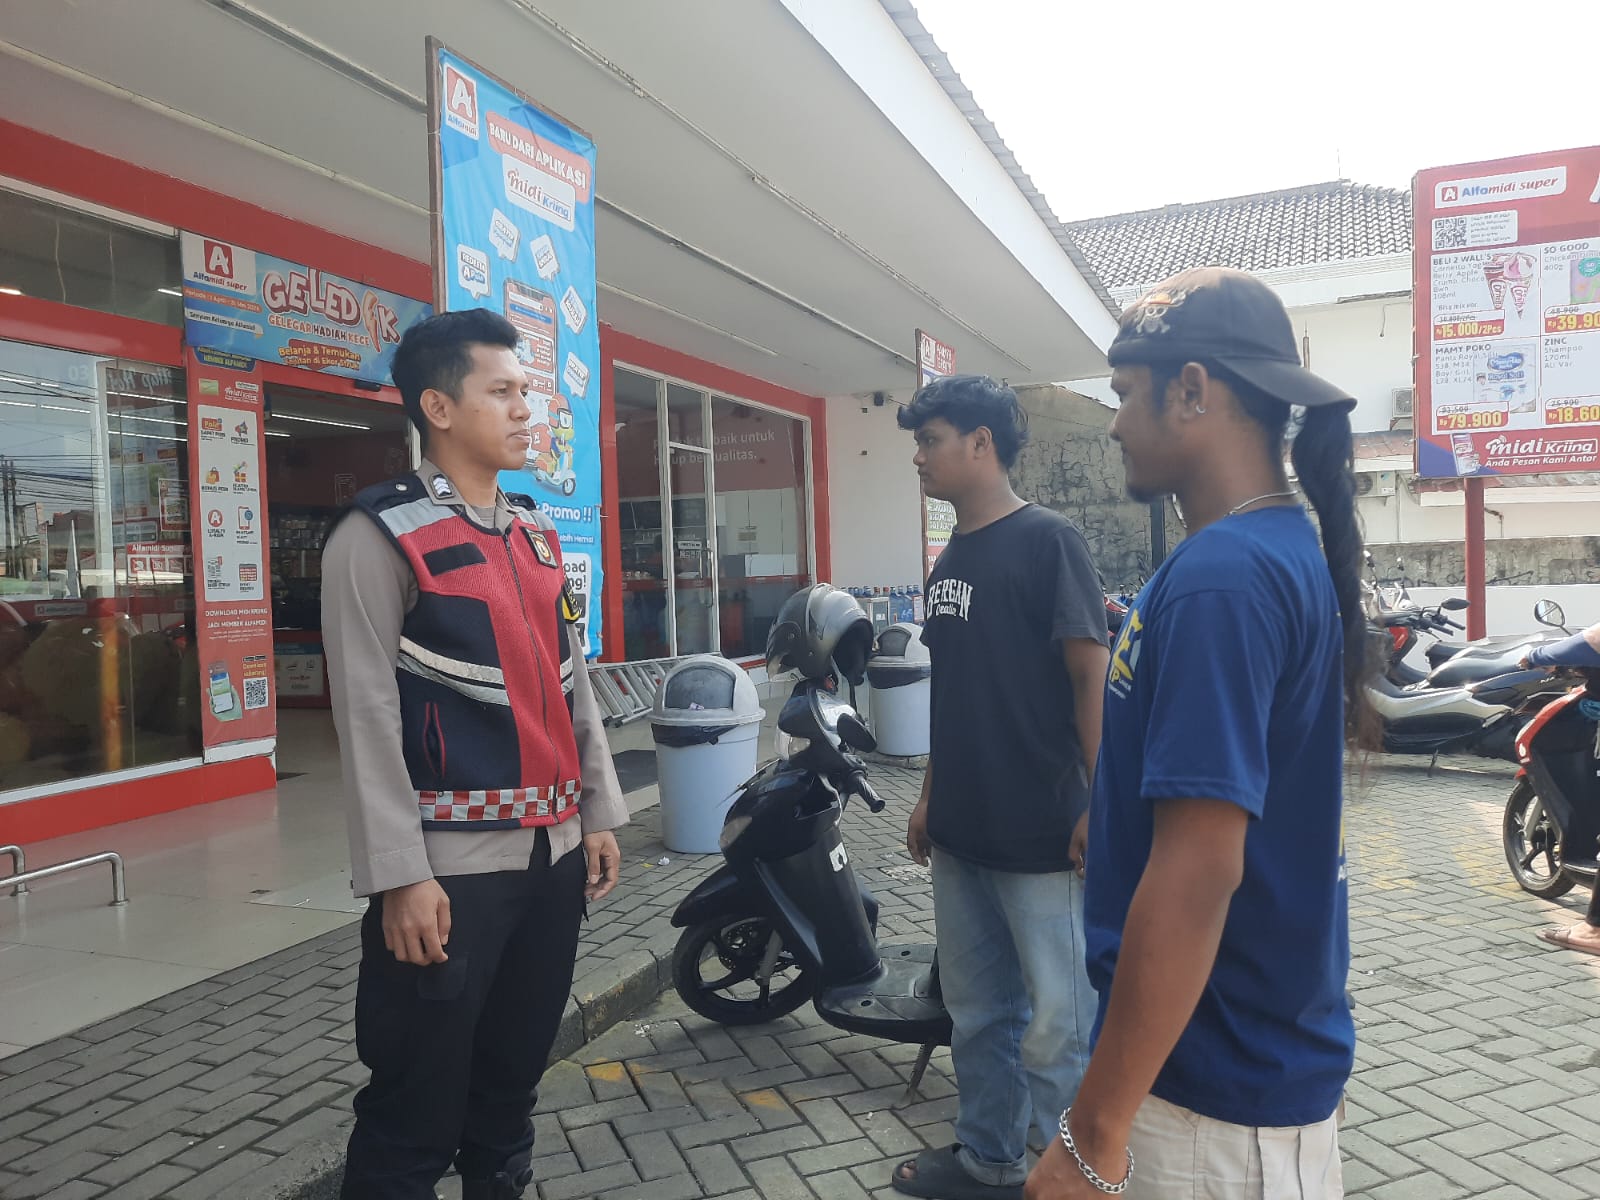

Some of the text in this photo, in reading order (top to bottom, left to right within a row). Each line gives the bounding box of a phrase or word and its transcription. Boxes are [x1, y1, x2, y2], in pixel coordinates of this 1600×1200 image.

[447, 114, 477, 137] Alfamidi
[489, 122, 586, 189] BARU DARI APLIKASI
[1461, 182, 1516, 198] Alfamidi
[1519, 176, 1558, 193] super
[507, 168, 569, 220] midi Kriing
[1543, 242, 1590, 255] SO GOOD
[1433, 257, 1451, 266] BELI
[1461, 254, 1491, 263] WALL'S
[1544, 252, 1577, 263] Chicken
[193, 270, 248, 292] Alfamidi super
[268, 314, 369, 346] GELEGAR HADIAH KECE
[1544, 337, 1567, 346] ZINC
[278, 345, 361, 361] Belanja & Temukan
[1435, 344, 1491, 355] MAMY POKO
[1544, 345, 1583, 354] Shampoo
[321, 356, 338, 366] Ekor
[1435, 354, 1457, 362] Pants
[1458, 353, 1480, 361] Royal
[1544, 353, 1570, 362] 170ml
[1447, 410, 1502, 429] 79.900
[740, 429, 775, 442] untuk
[1485, 437, 1593, 456] midi Kriing
[1486, 453, 1597, 467] Anda Pesan Kami Antar
[542, 502, 580, 521] Promo
[558, 534, 573, 543] ebih
[131, 543, 160, 552] Alfamidi
[926, 578, 973, 622] BERGAN
[205, 609, 237, 617] DOWNLOAD
